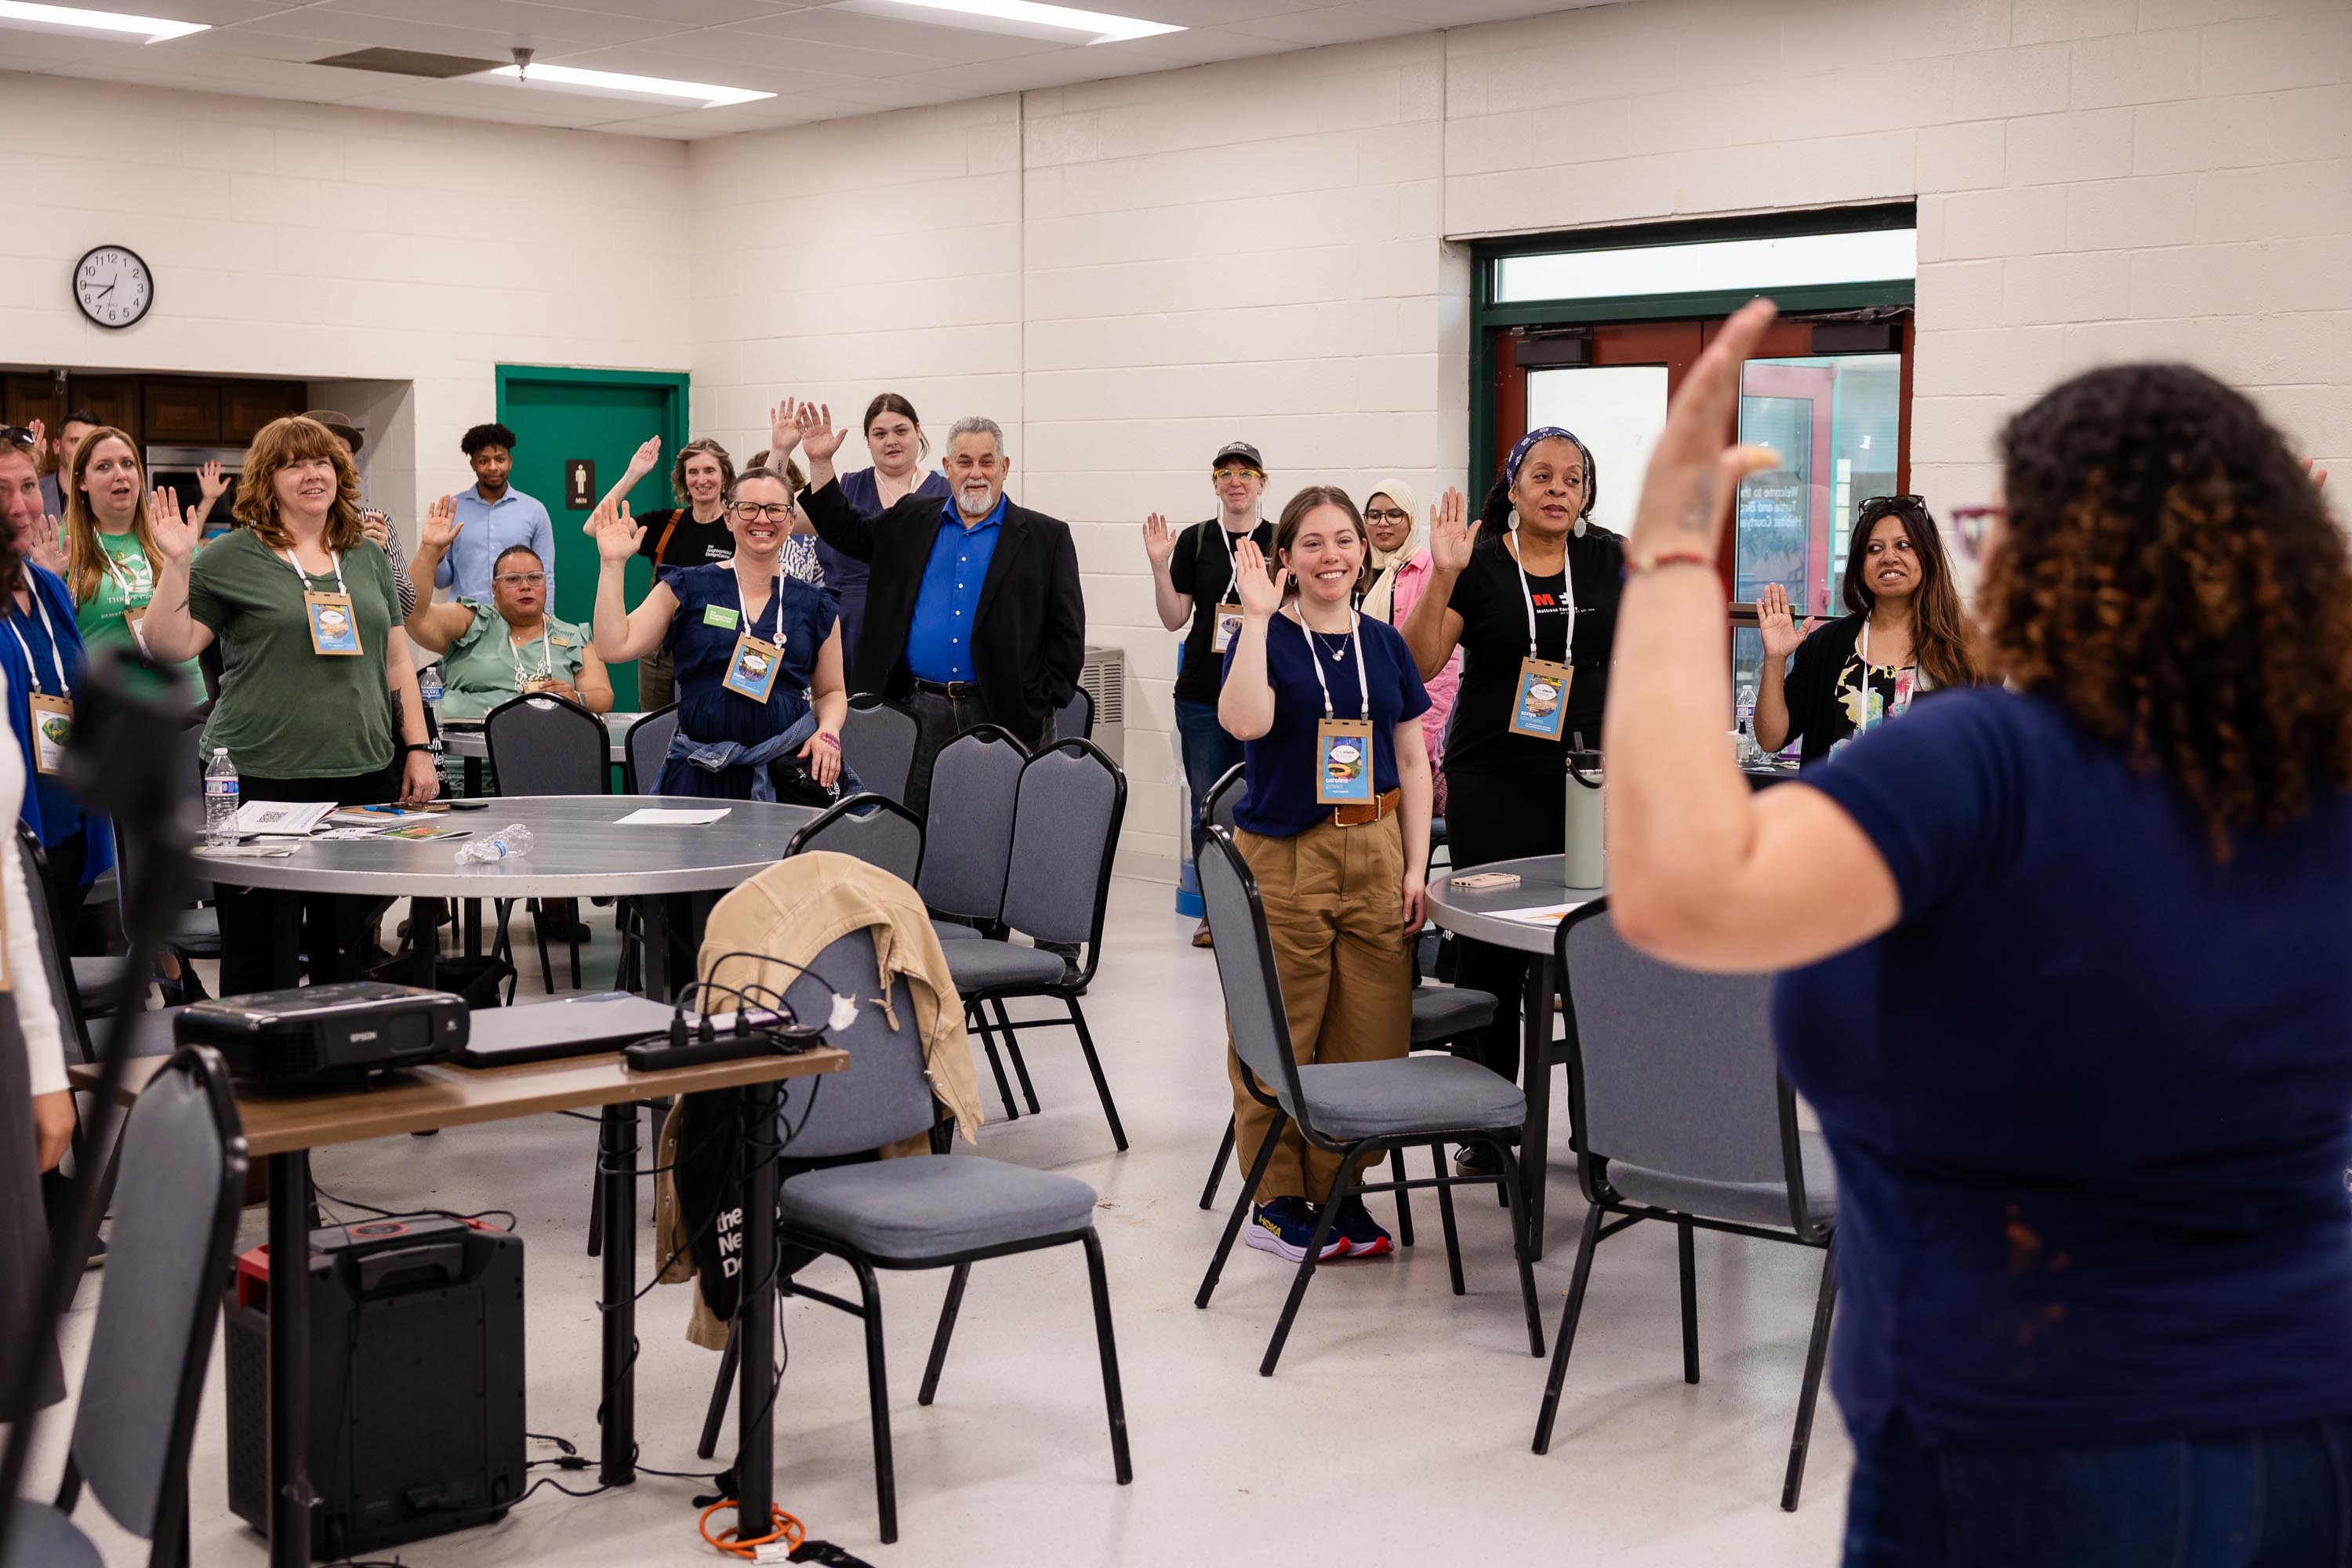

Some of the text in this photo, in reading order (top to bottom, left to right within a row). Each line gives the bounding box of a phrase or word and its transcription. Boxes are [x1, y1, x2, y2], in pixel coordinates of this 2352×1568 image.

[95, 255, 103, 266] 11
[107, 252, 118, 263] 12
[123, 256, 127, 267] 1
[85, 266, 96, 277] 10
[132, 268, 140, 278] 2
[79, 280, 87, 290] 9
[137, 283, 144, 293] 3
[84, 293, 91, 304] 8
[132, 298, 140, 307] 4
[95, 304, 102, 315] 7
[122, 307, 130, 318] 5
[109, 310, 116, 321] 6
[1531, 593, 1555, 606] M
[717, 1207, 743, 1233] the
[1258, 1214, 1281, 1237] HOKA
